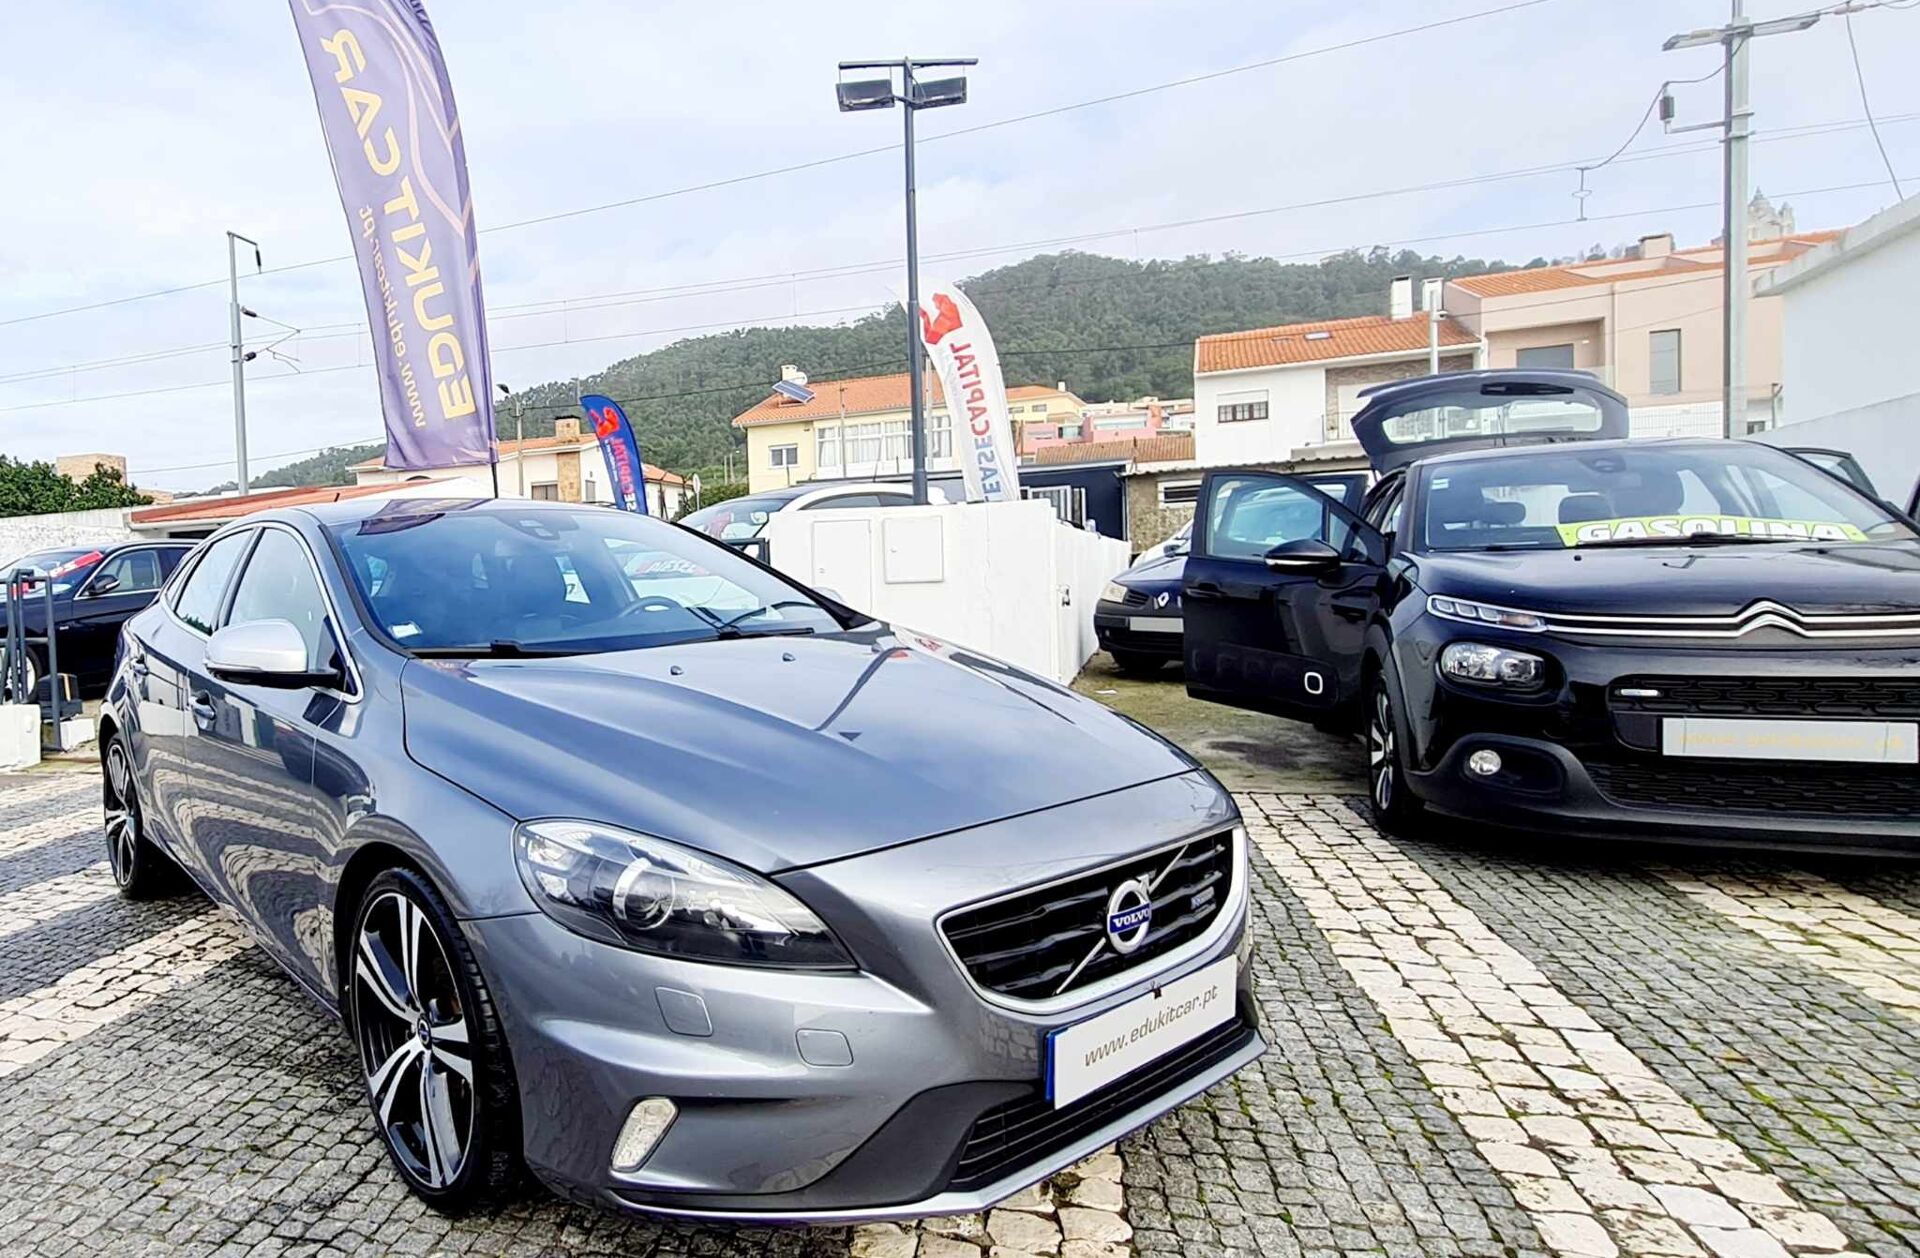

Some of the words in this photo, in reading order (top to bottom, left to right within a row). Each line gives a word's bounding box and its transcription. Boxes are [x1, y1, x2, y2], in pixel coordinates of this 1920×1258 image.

[1575, 517, 1849, 543] GASOLINA
[1113, 904, 1150, 928] VOLVO
[1084, 985, 1219, 1067] www.edukitcar.pt
